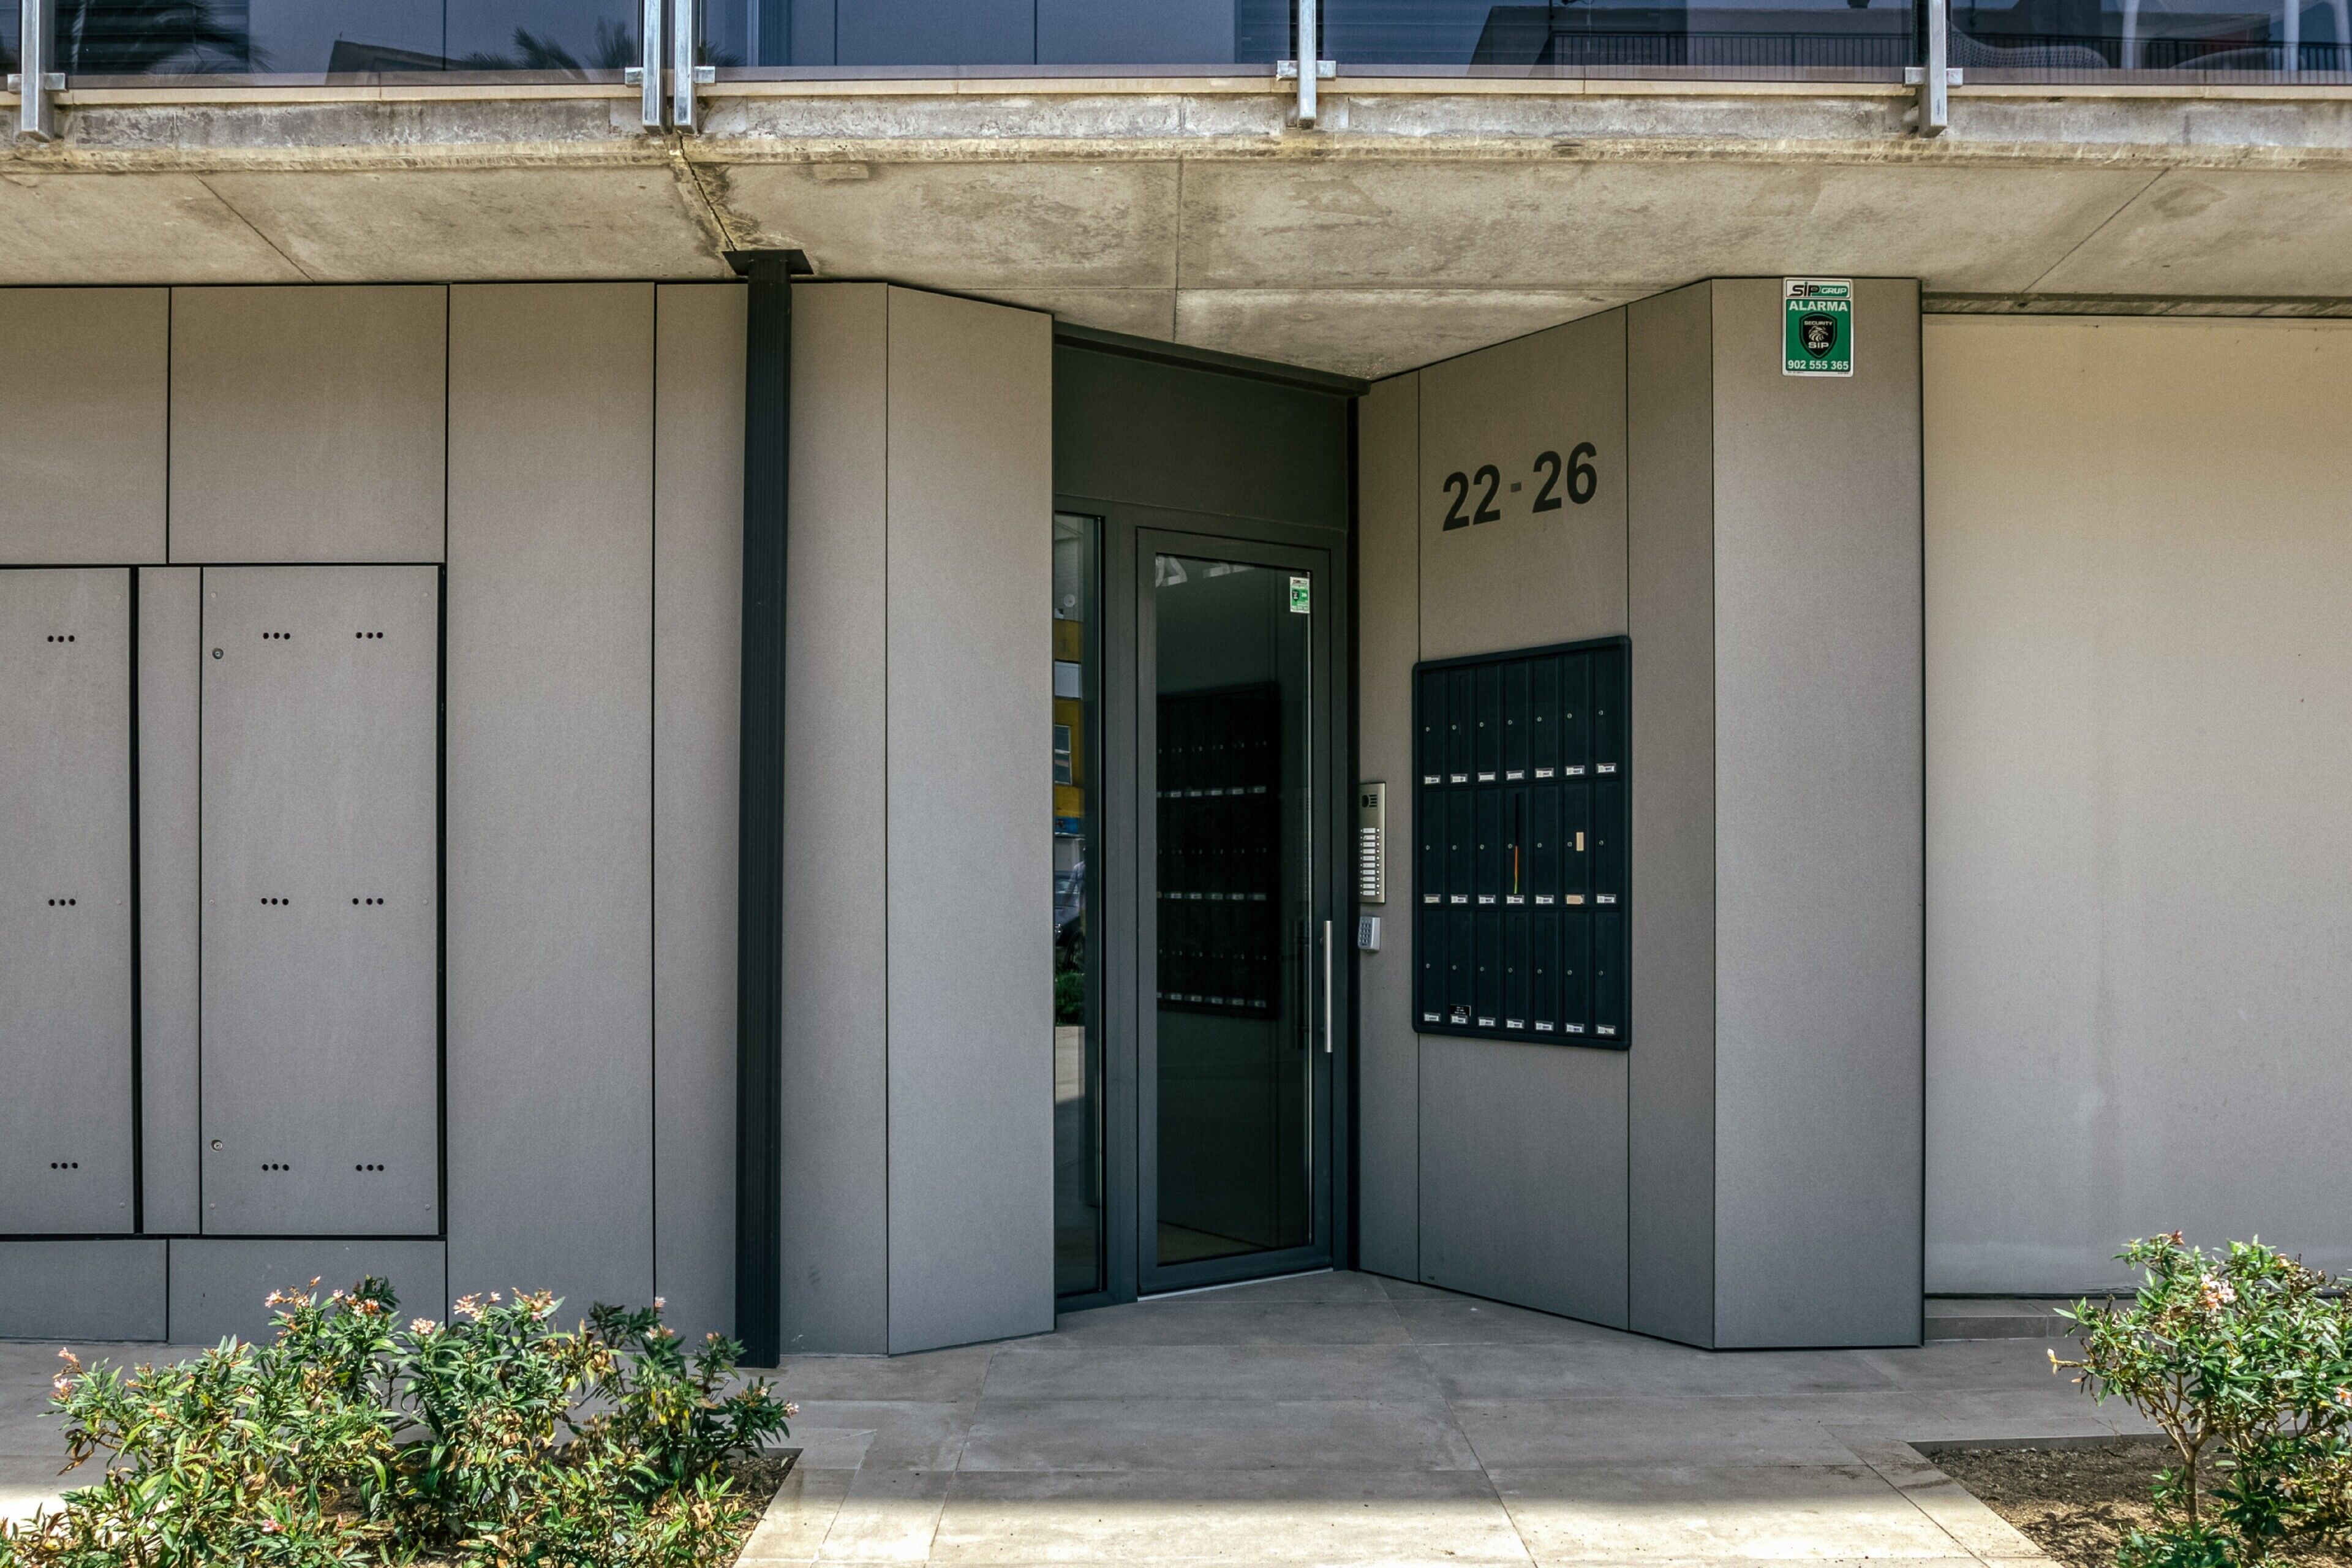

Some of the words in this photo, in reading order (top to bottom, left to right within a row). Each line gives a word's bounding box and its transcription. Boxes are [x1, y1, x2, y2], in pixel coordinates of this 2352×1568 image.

[1789, 301, 1849, 312] ALARMA
[1788, 360, 1806, 369] 902
[1809, 360, 1828, 369] 555
[1831, 360, 1849, 370] 365
